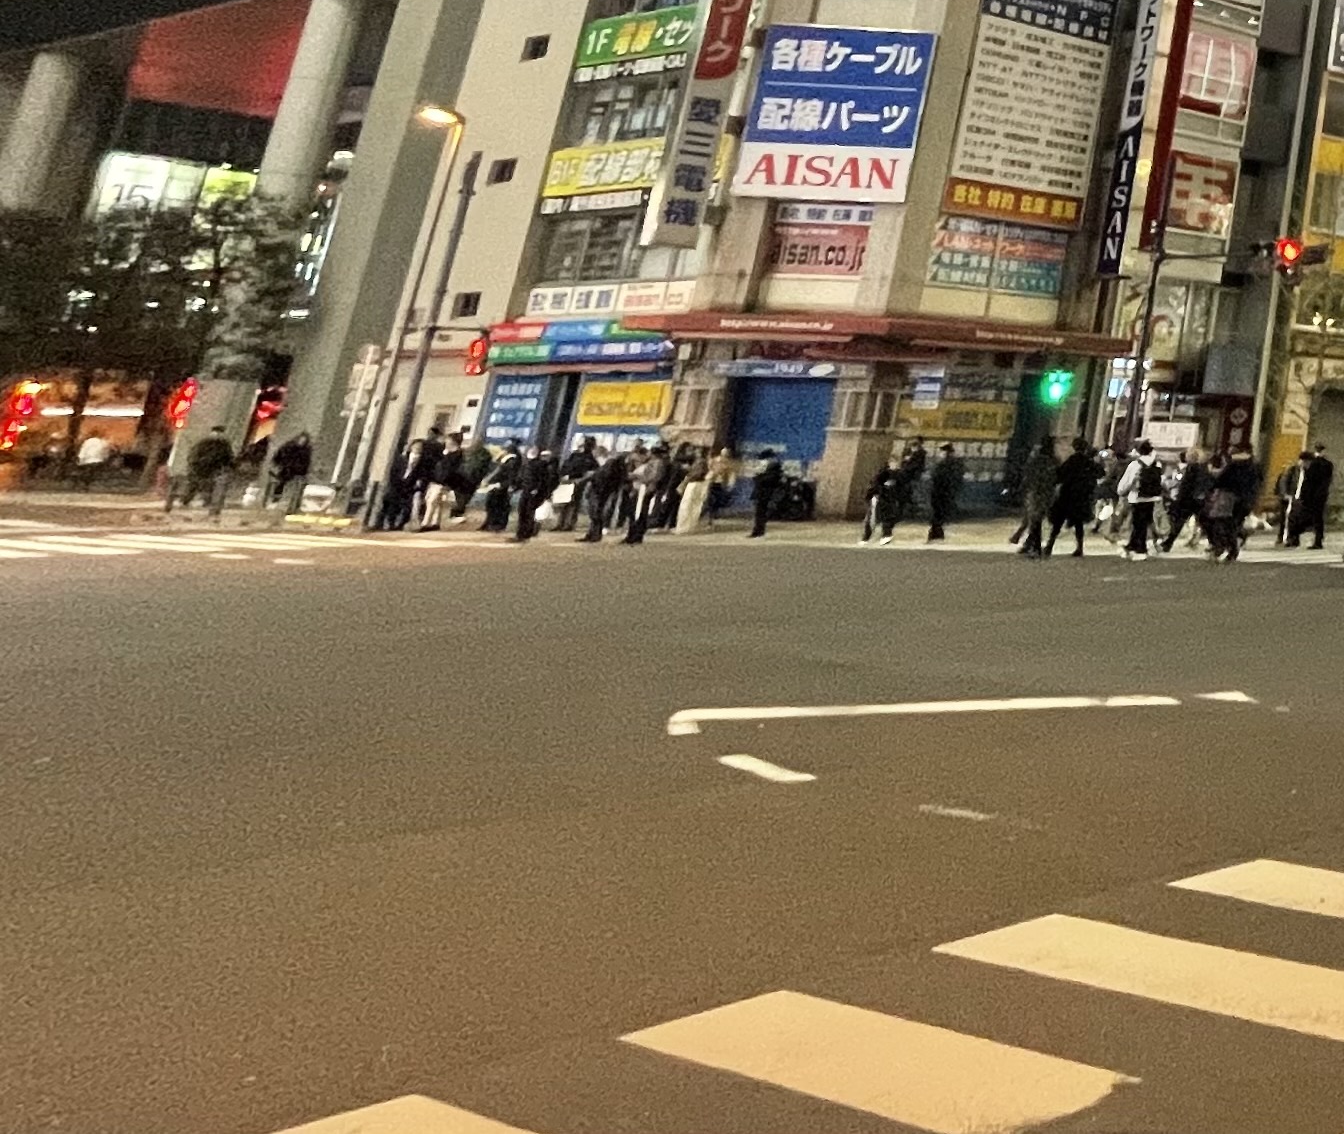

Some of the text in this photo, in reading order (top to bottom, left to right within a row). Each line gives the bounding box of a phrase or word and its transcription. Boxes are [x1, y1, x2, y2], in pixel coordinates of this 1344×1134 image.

[586, 28, 612, 55] 1F
[770, 37, 924, 76] 各種ケーブル
[755, 94, 913, 134] 配線パーツ
[742, 152, 901, 192] AISAN
